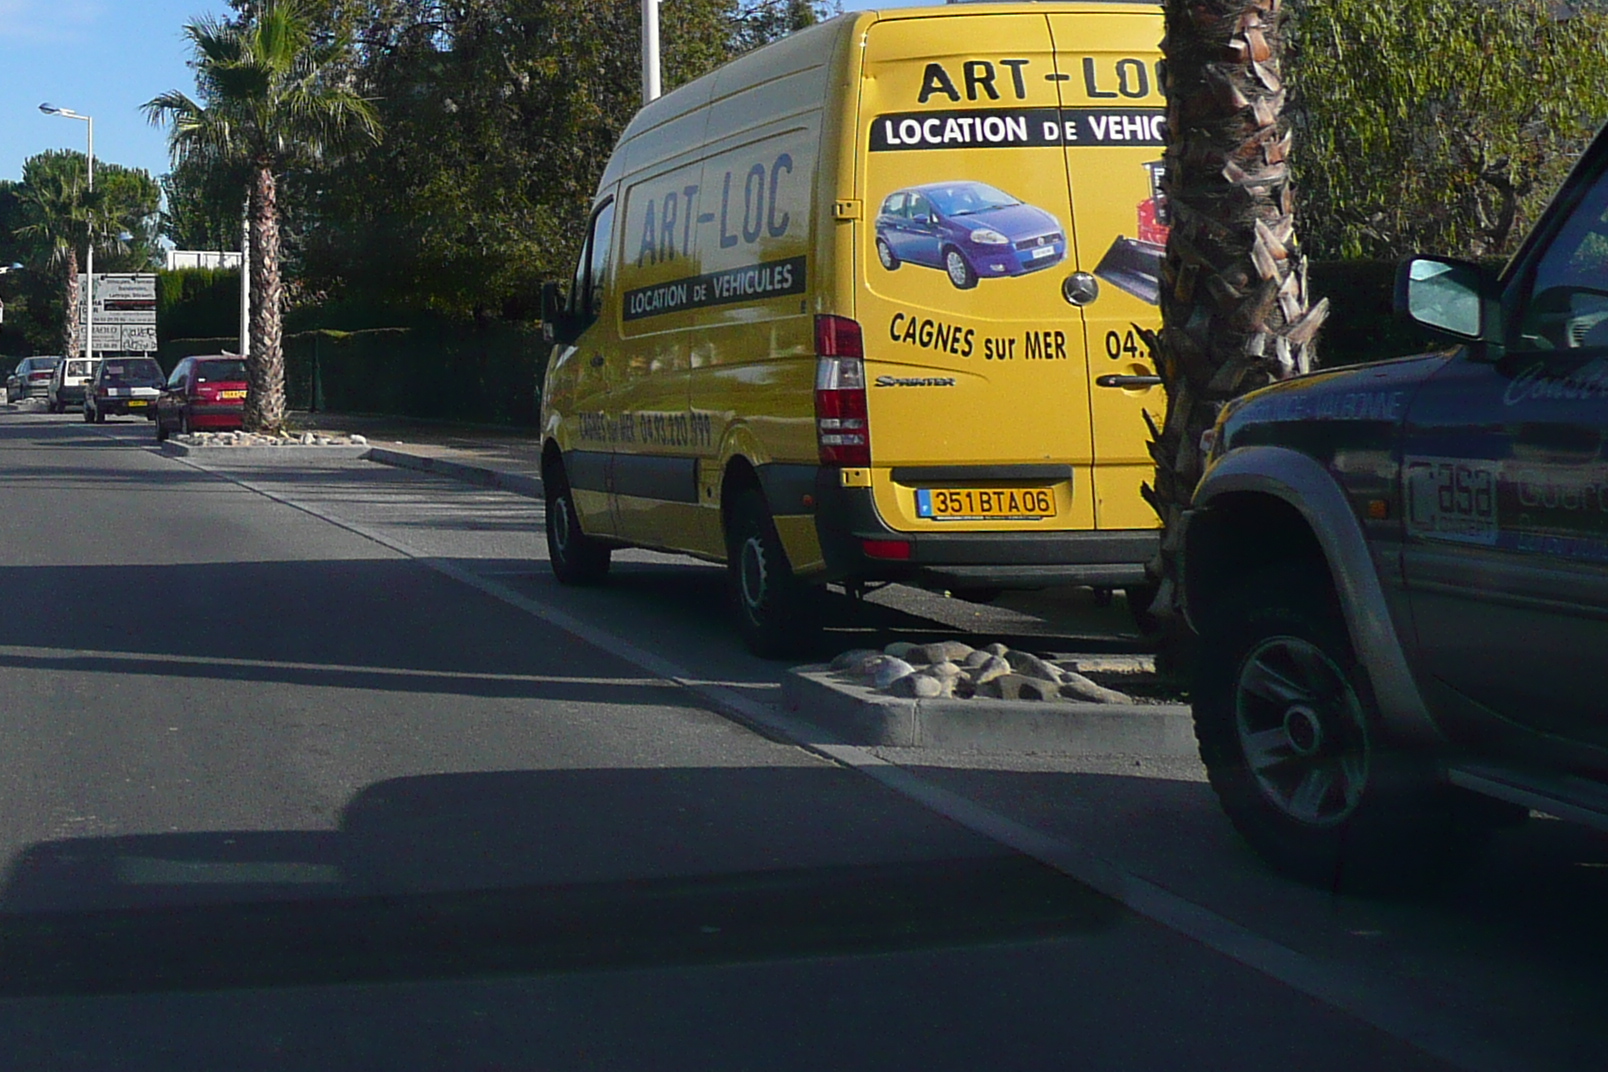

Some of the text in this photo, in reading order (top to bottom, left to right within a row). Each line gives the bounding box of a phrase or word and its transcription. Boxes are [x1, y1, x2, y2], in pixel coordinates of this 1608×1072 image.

[917, 57, 1167, 104] ART-LO
[885, 115, 1028, 145] LOCATION
[1042, 120, 1078, 141] DE
[638, 153, 793, 269] ART-LOC
[630, 264, 793, 314] LOCATION DE VEHICULES
[890, 312, 1067, 360] CAGNES sur MER
